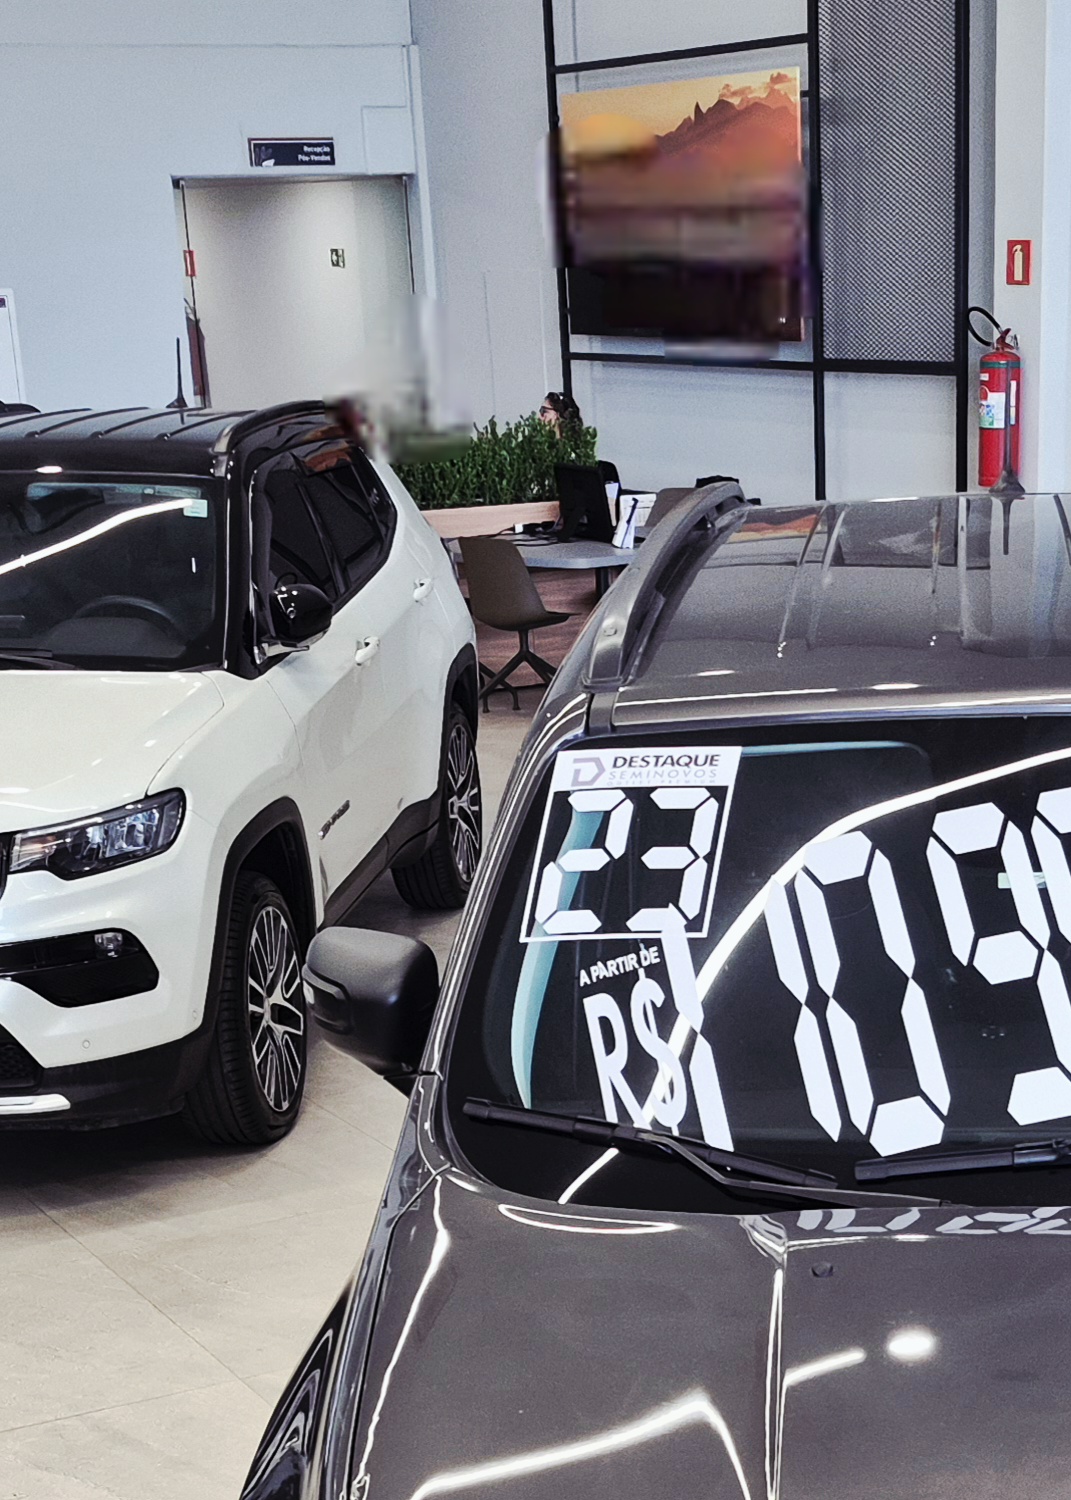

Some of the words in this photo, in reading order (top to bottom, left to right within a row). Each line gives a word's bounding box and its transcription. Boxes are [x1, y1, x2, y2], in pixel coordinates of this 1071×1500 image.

[608, 768, 718, 781] SEMINOVOS
[612, 754, 721, 769] DESTAQUE
[535, 788, 719, 934] 23
[579, 969, 591, 987] A
[590, 953, 640, 983] PARTIR
[640, 946, 661, 968] DE
